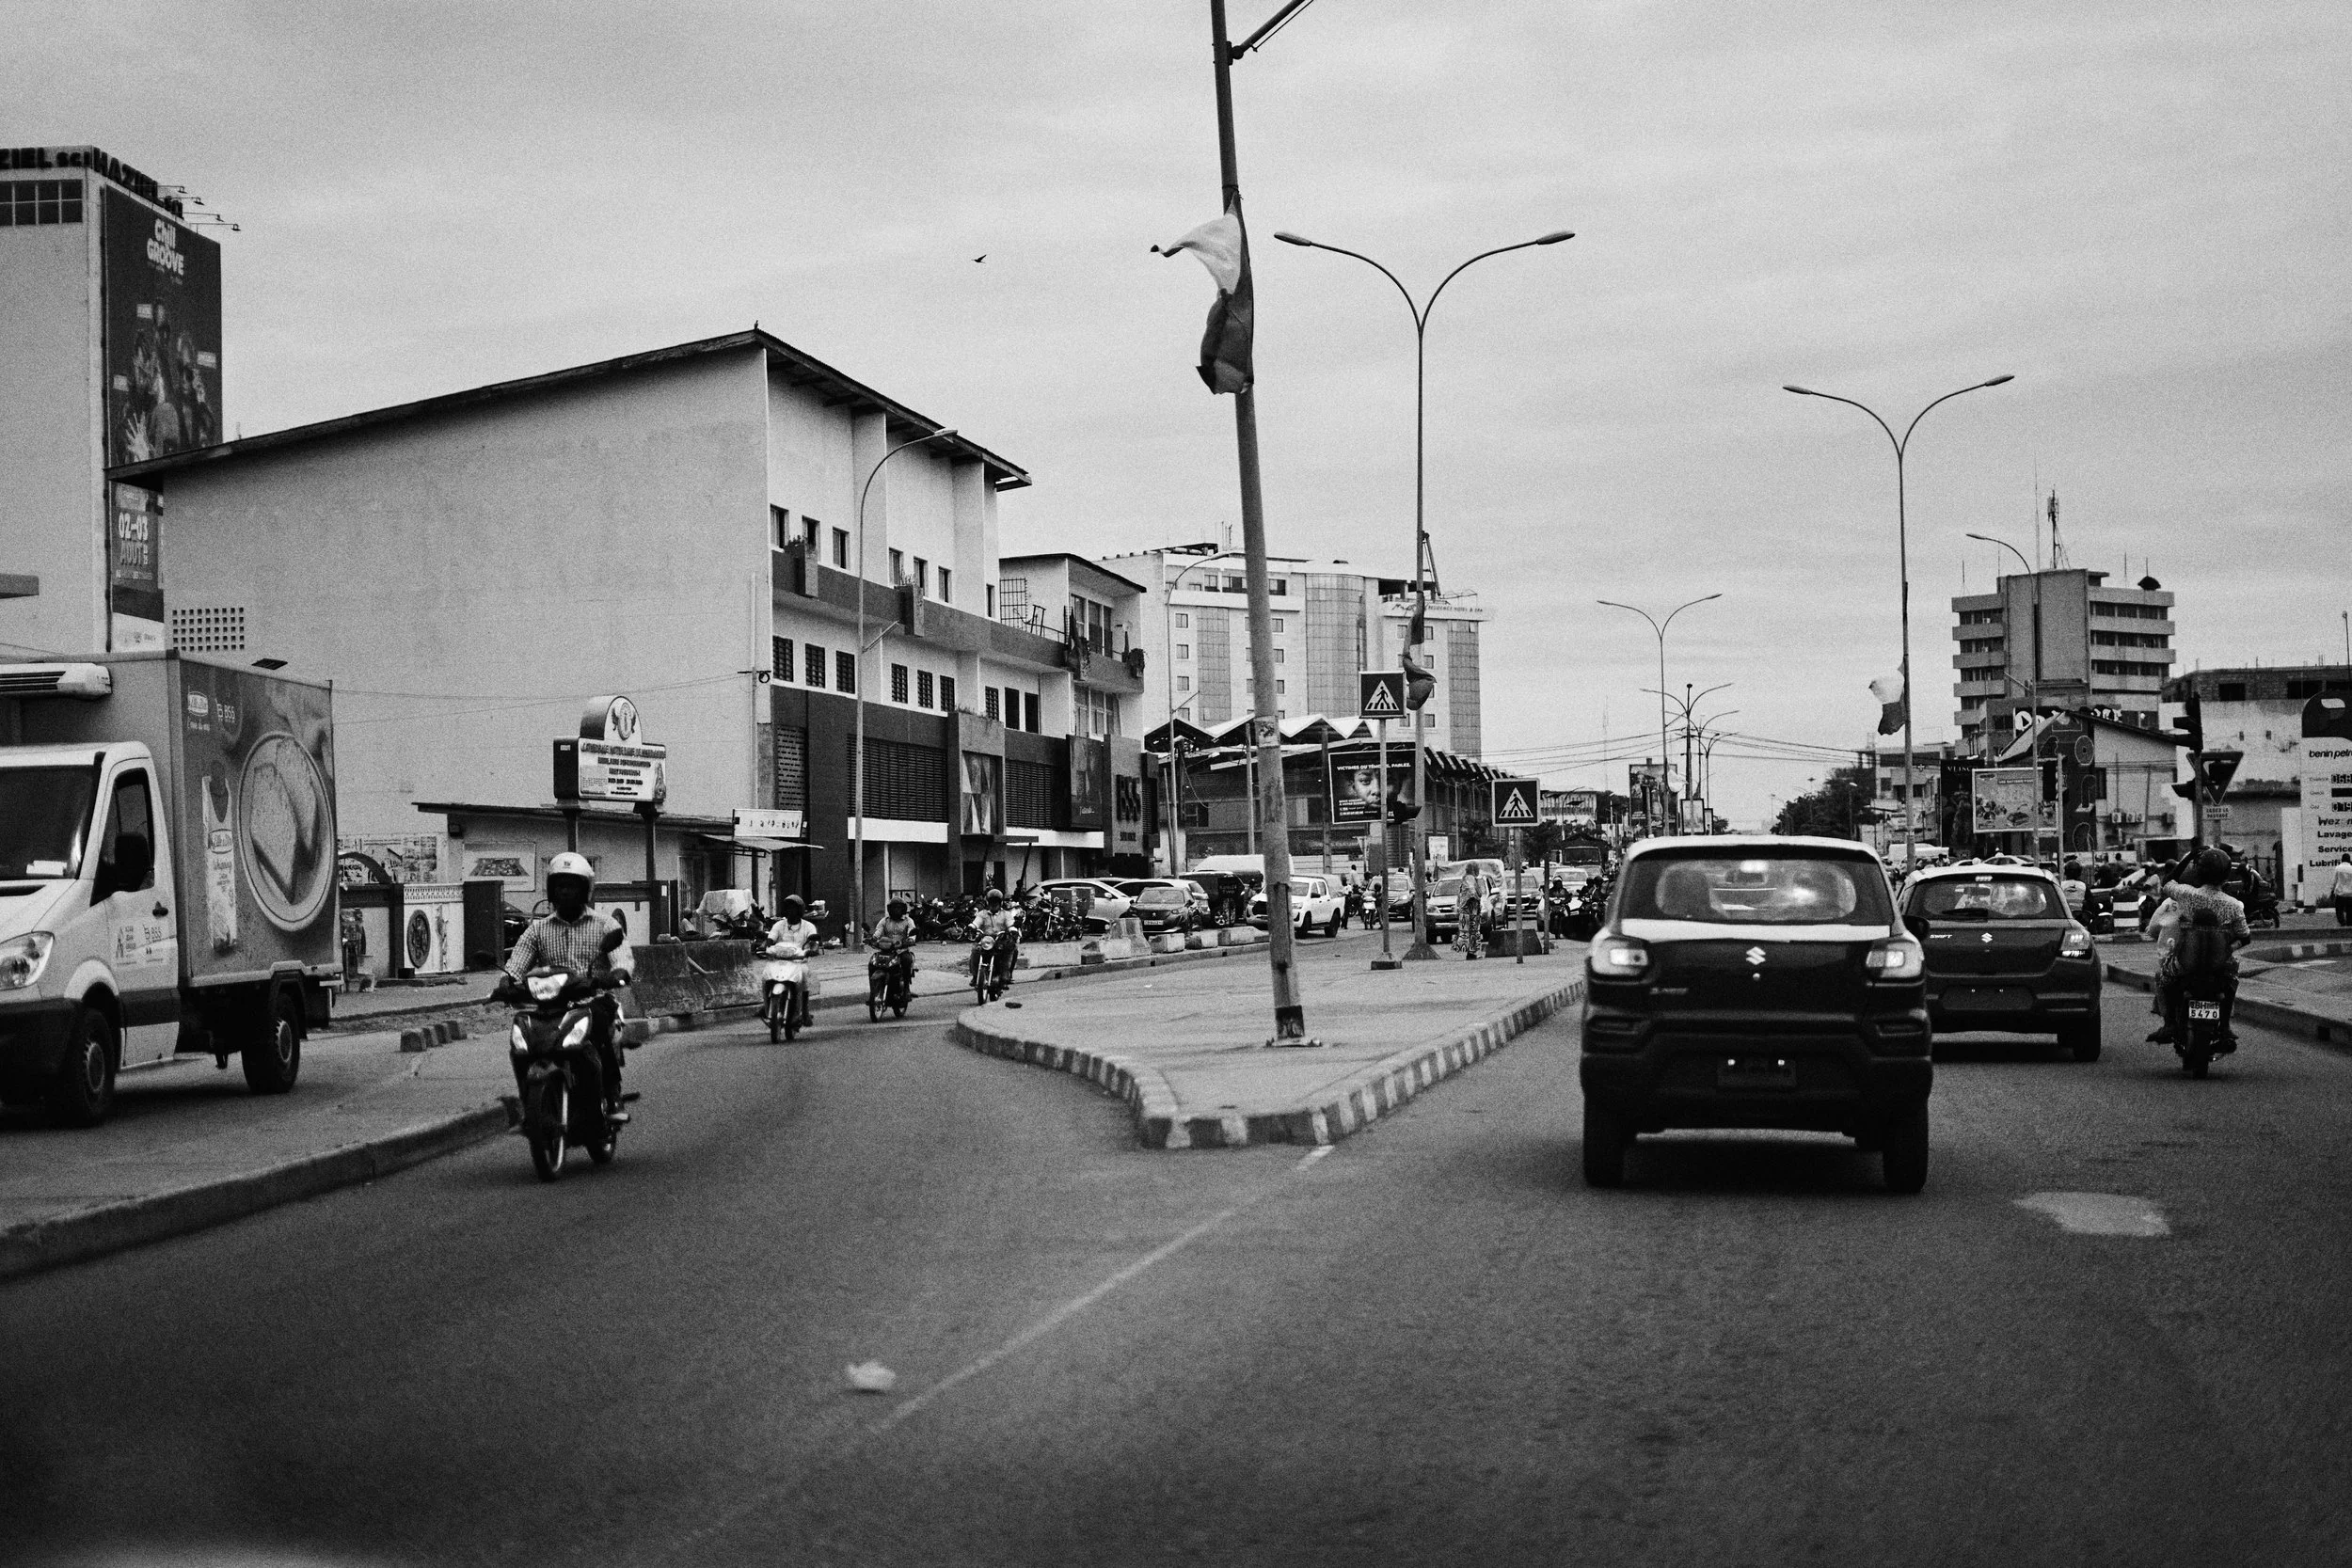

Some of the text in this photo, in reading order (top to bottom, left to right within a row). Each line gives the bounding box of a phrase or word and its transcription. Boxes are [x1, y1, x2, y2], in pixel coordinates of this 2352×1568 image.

[154, 217, 177, 249] Chill
[147, 237, 184, 277] GROOVE
[2309, 750, 2333, 758] benin
[2317, 831, 2352, 839] Lavage
[2191, 1009, 2218, 1019] 5470
